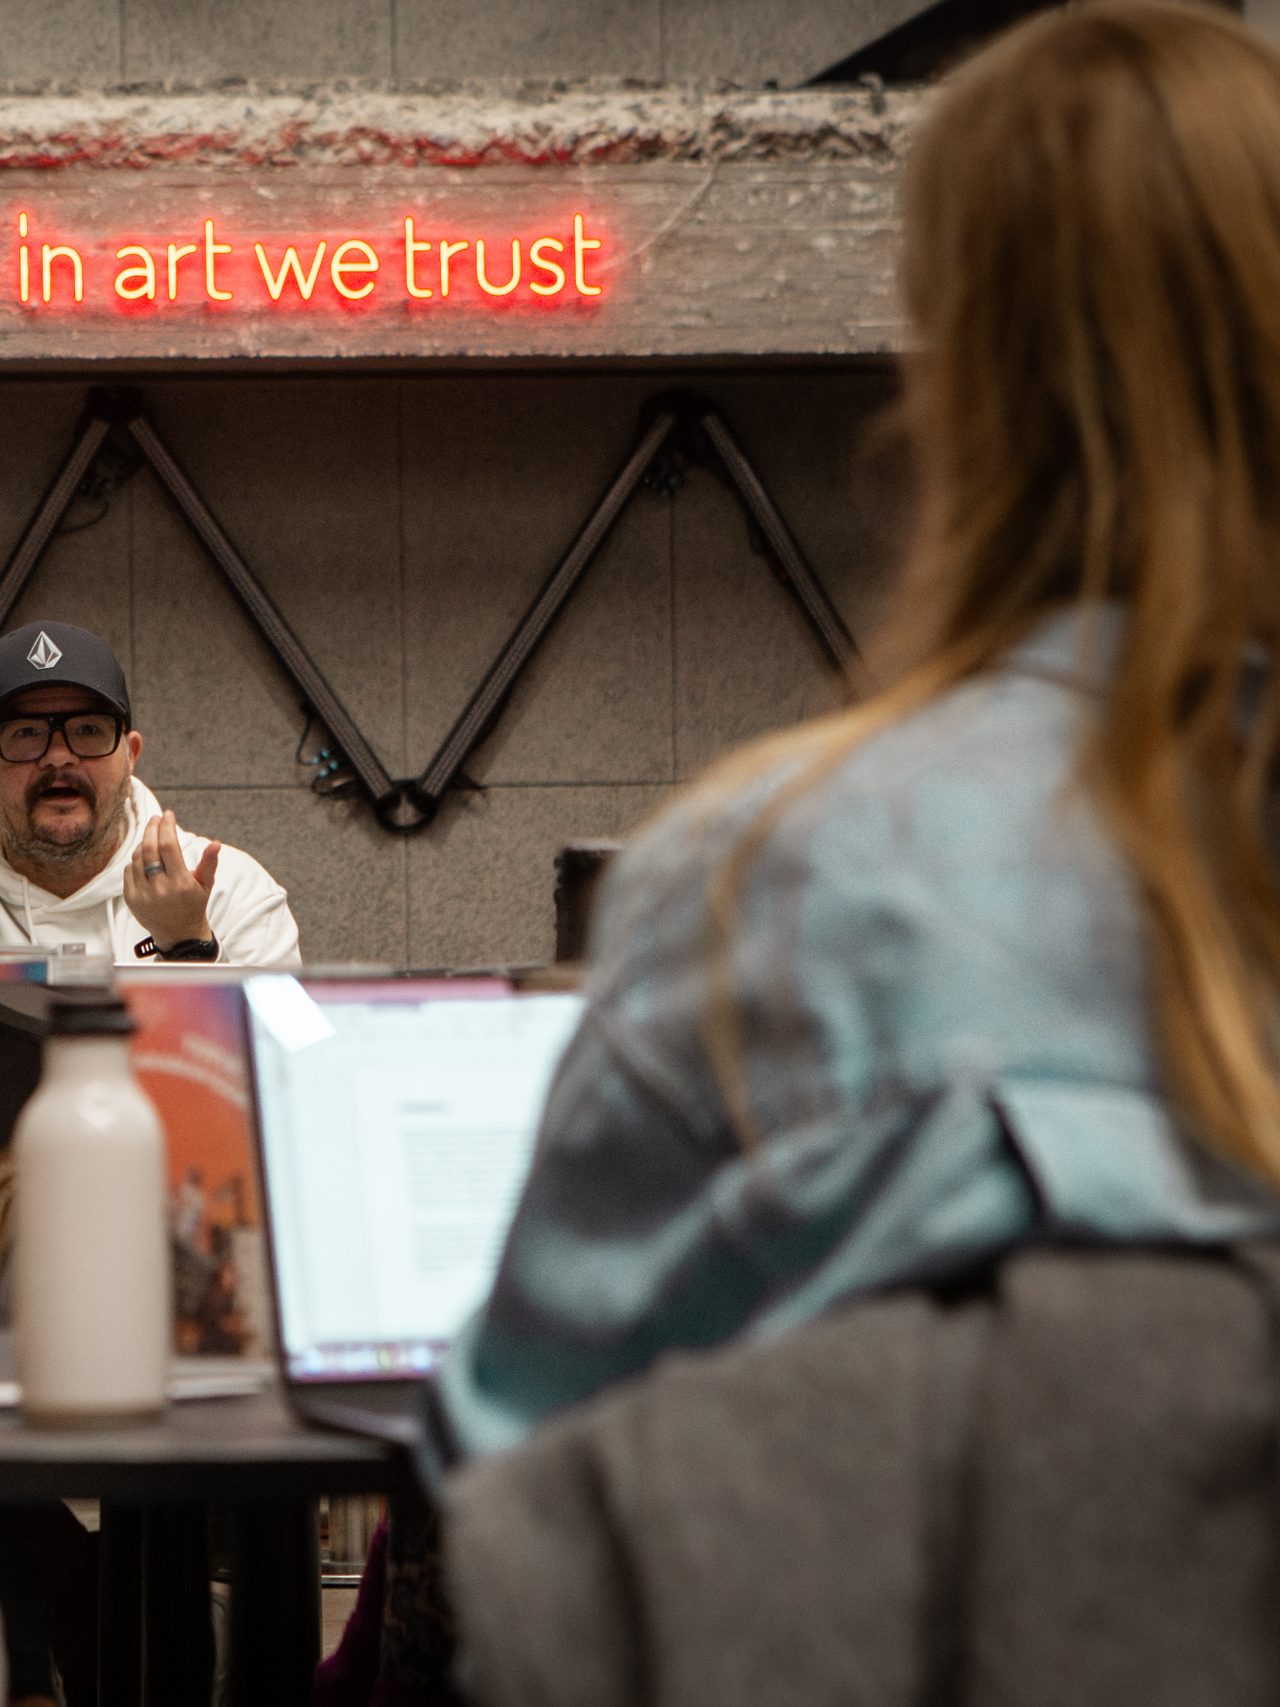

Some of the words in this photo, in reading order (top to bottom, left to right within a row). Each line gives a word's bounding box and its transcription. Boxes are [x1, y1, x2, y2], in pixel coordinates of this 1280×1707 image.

[18, 211, 84, 303] in
[114, 218, 233, 302] art
[254, 239, 380, 300] we
[404, 213, 603, 298] trust
